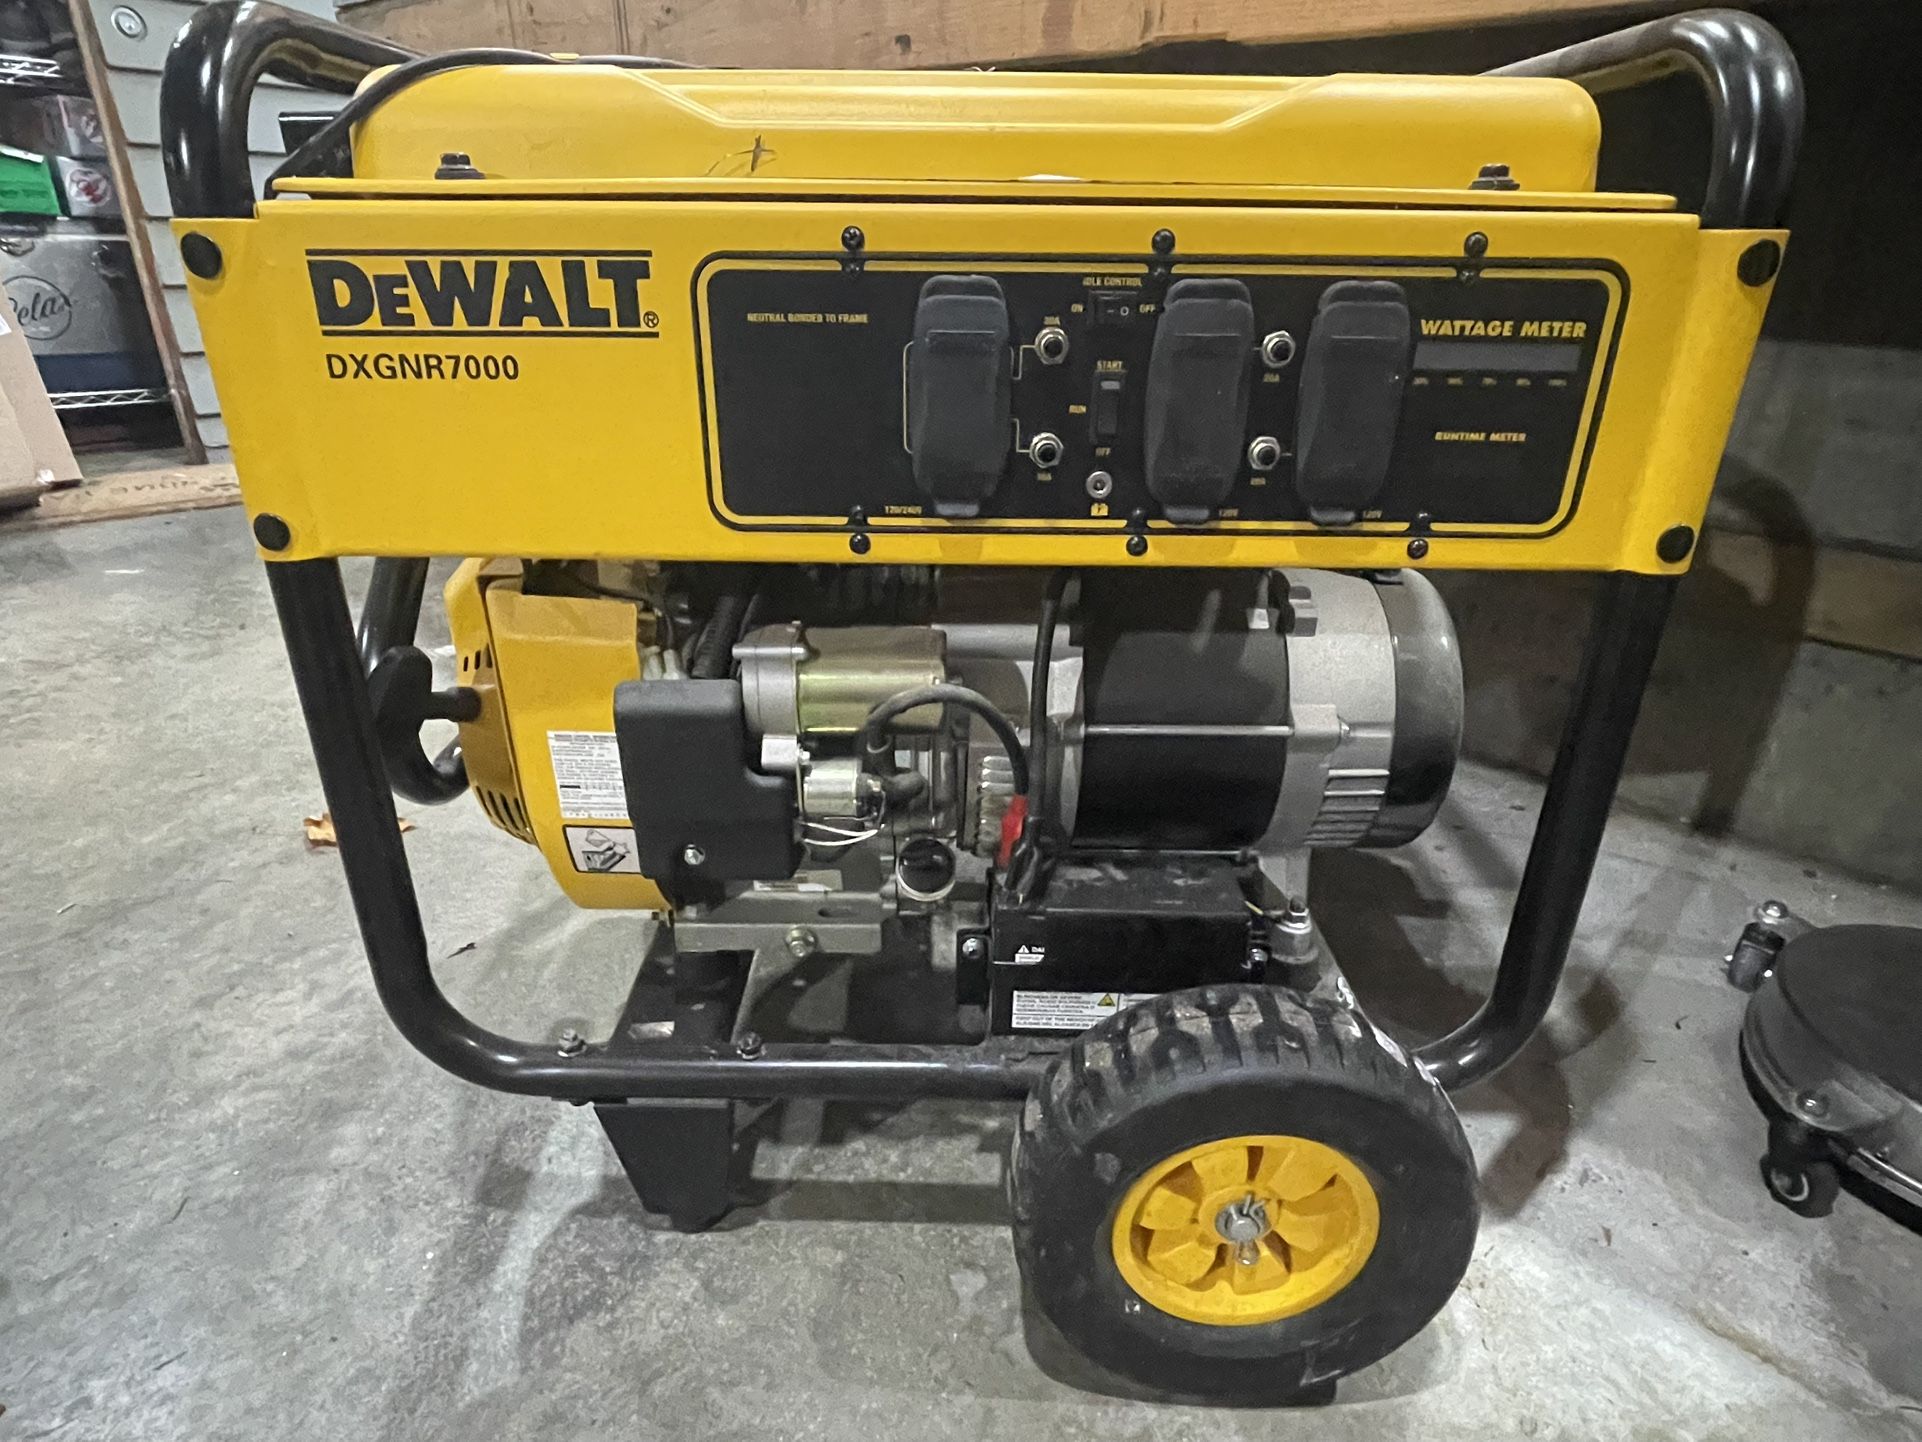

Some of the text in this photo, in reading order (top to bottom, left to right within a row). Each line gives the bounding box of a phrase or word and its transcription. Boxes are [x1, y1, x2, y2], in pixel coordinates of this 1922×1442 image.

[1104, 277, 1142, 287] CONTROL
[747, 313, 786, 323] NEUTRAL
[825, 313, 836, 323] TO
[838, 313, 868, 324] FRAME
[1421, 319, 1587, 338] WATTAGE METER
[326, 353, 520, 380] DXGNR7000
[1097, 360, 1123, 370] START
[1434, 432, 1526, 441] RUNTIME METER
